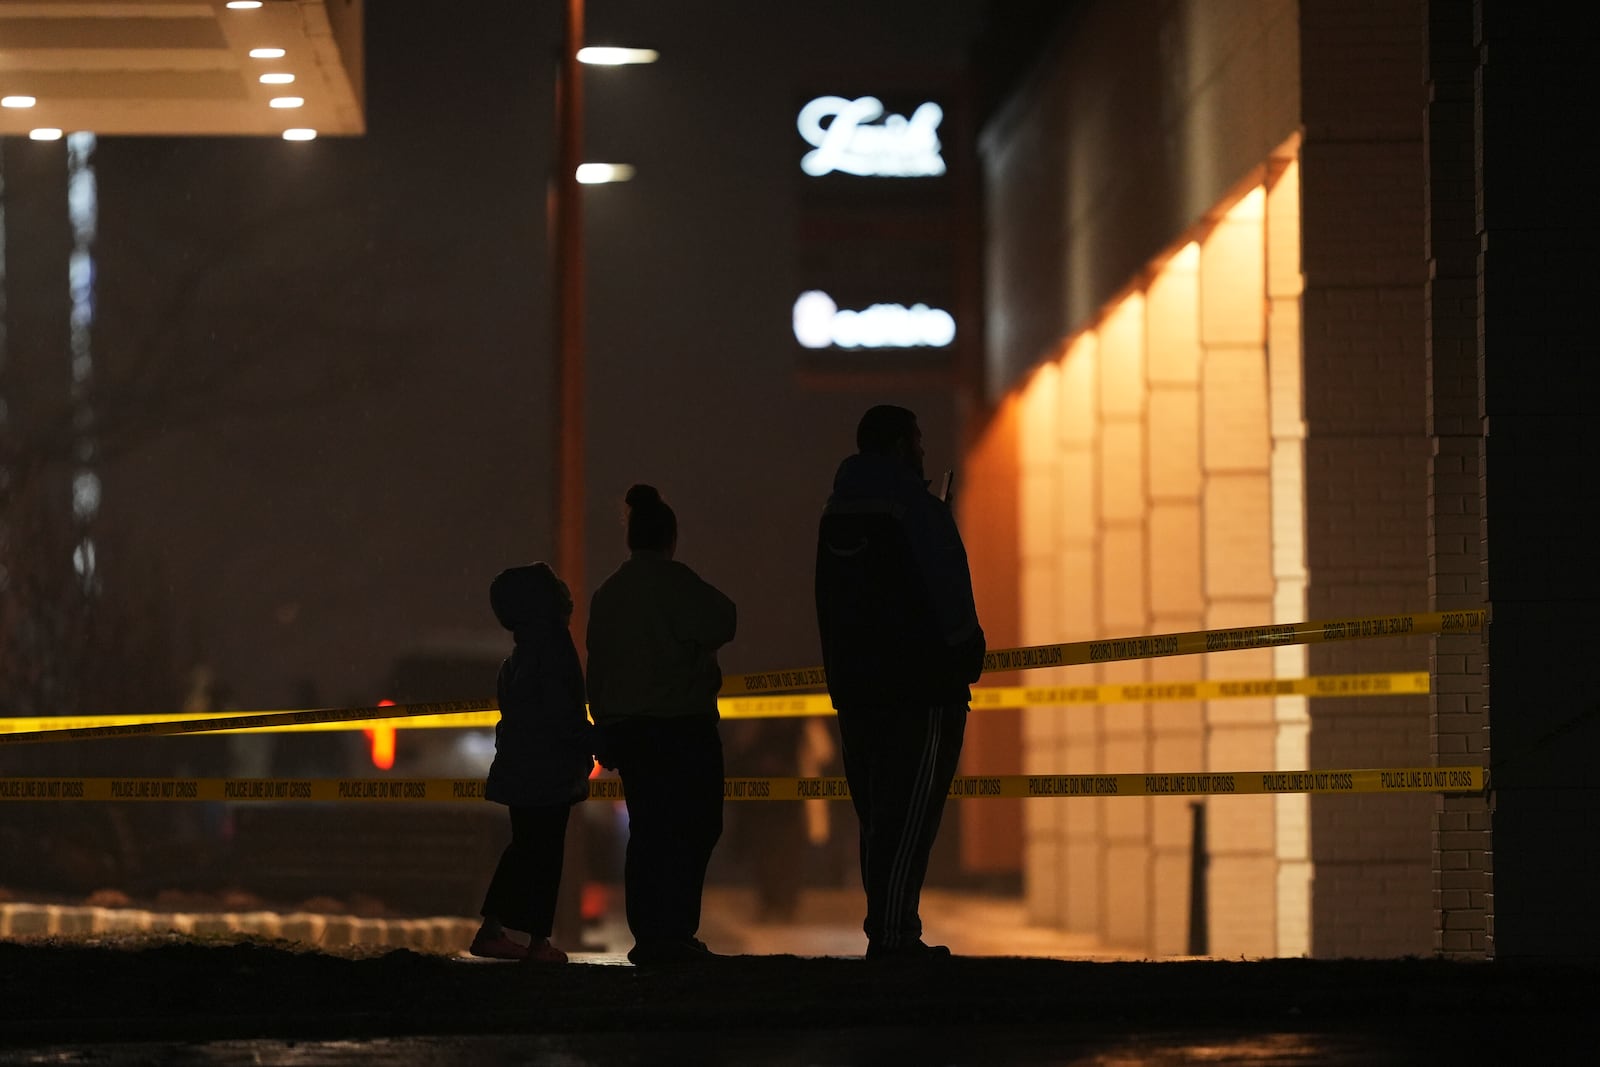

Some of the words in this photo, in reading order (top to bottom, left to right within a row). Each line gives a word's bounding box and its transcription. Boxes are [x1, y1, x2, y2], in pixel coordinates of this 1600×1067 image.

[954, 780, 962, 795] DO
[965, 780, 978, 795] NOT
[980, 779, 1000, 795] CROSS
[1029, 779, 1052, 795] POLICE
[1054, 778, 1068, 794] LINE
[1070, 778, 1078, 794] DO
[1080, 778, 1093, 794] NOT
[1096, 777, 1118, 793] CROSS
[1146, 777, 1168, 792] POLICE
[1170, 777, 1184, 792] LINE
[1186, 776, 1196, 792] DO
[1198, 776, 1210, 792] NOT
[1213, 776, 1234, 792] CROSS
[1263, 776, 1286, 790] POLICE
[1288, 775, 1302, 790] LINE
[1304, 774, 1314, 790] DO
[1316, 774, 1328, 790] NOT
[1330, 774, 1352, 789] CROSS
[1381, 772, 1404, 788] POLICE
[1406, 772, 1421, 788] LINE
[1424, 772, 1432, 787] DO
[1434, 772, 1446, 786] NOT
[1450, 771, 1472, 786] CROSS
[22, 782, 36, 797] LINE
[37, 782, 46, 797] DO
[49, 782, 60, 797] NOT
[62, 782, 84, 797] CROSS
[111, 782, 133, 797] POLICE
[136, 782, 150, 797] LINE
[151, 782, 160, 797] DO
[162, 782, 174, 797] NOT
[176, 782, 197, 797] CROSS
[224, 782, 248, 797] POLICE
[249, 782, 263, 797] LINE
[264, 782, 273, 797] DO
[276, 782, 289, 797] NOT
[290, 782, 312, 797] CROSS
[338, 782, 362, 797] POLICE
[363, 782, 378, 797] LINE
[379, 782, 388, 797] DO
[390, 782, 402, 797] NOT
[404, 782, 426, 797] CROSS
[453, 782, 476, 797] POLICE
[592, 782, 607, 797] LINE
[608, 782, 616, 797] DO
[724, 781, 732, 796] DO
[734, 781, 746, 796] NOT
[748, 781, 770, 796] CROSS
[798, 781, 820, 796] POLICE
[822, 781, 836, 796] LINE
[838, 781, 847, 796] DO
